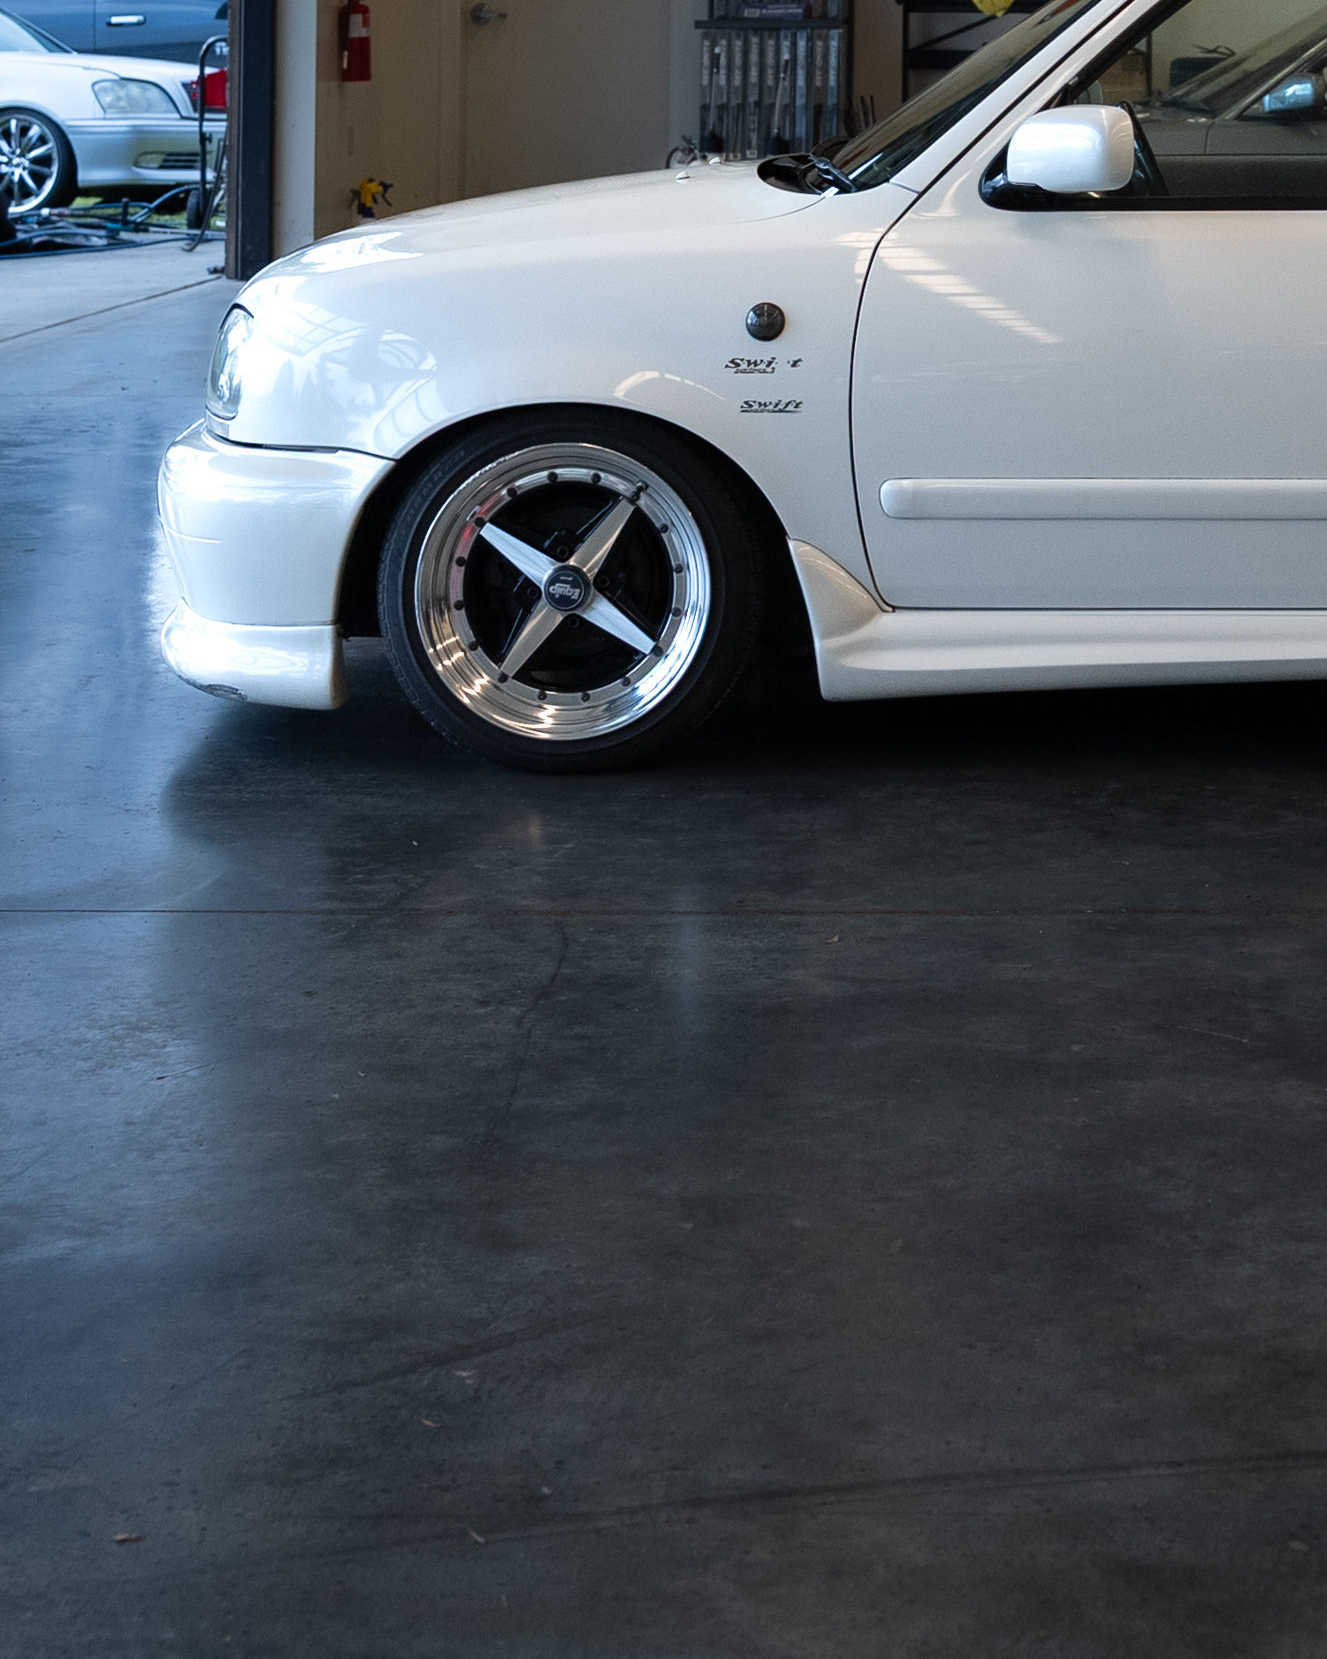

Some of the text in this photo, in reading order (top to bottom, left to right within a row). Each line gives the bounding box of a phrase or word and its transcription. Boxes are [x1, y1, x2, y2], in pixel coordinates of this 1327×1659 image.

[724, 357, 803, 368] Swit
[740, 400, 802, 409] Swift
[549, 583, 580, 599] Equip
